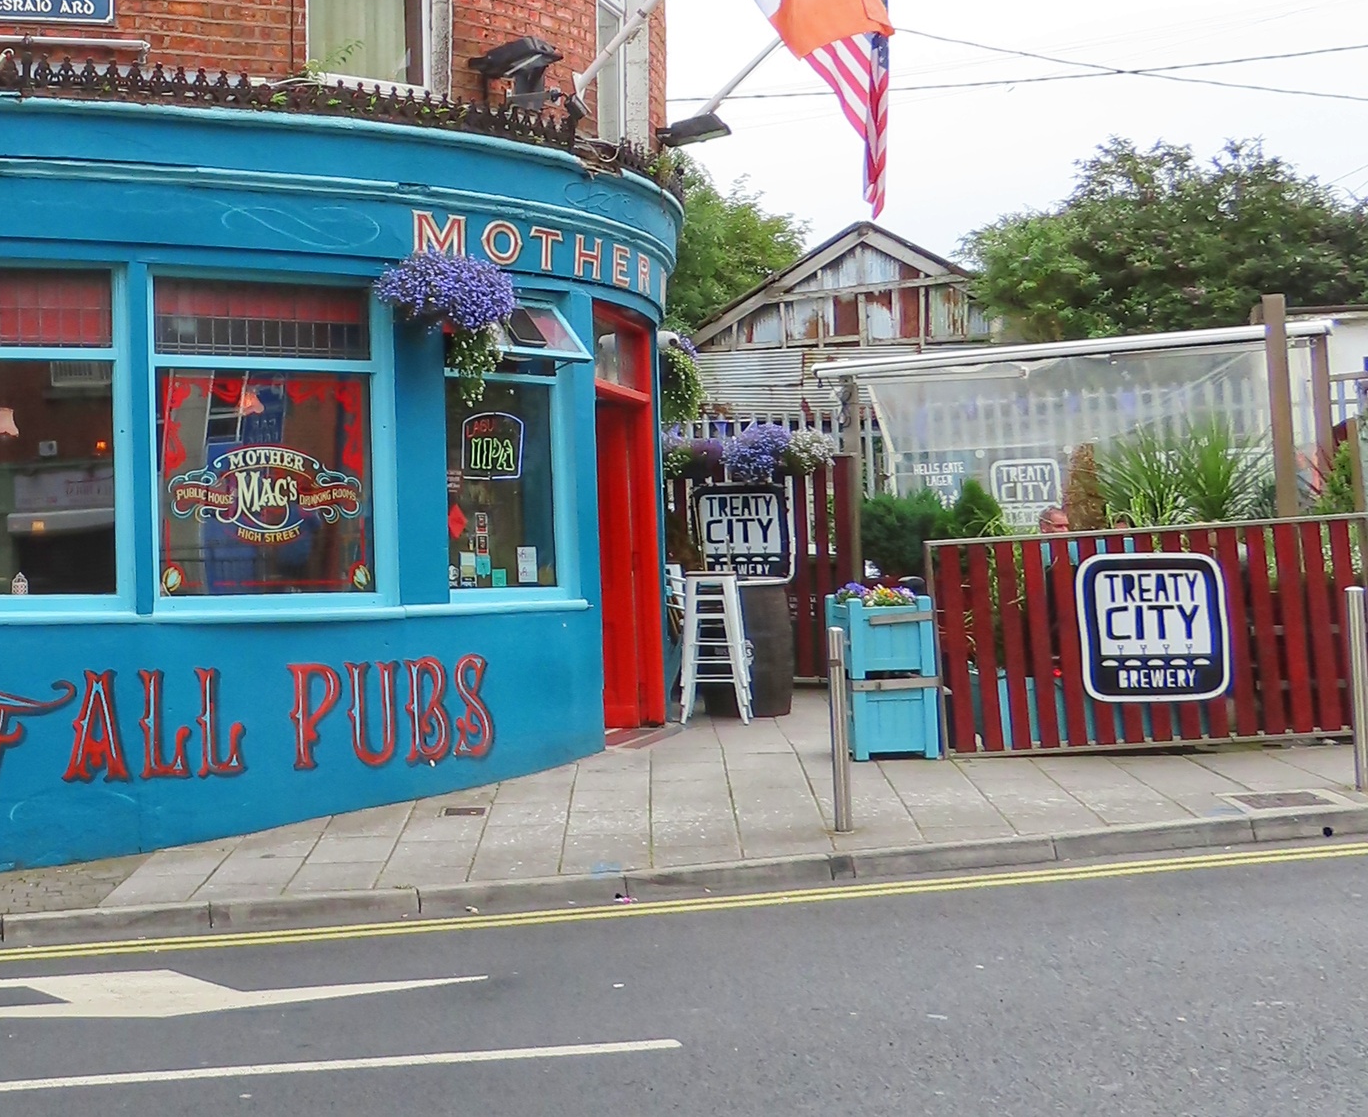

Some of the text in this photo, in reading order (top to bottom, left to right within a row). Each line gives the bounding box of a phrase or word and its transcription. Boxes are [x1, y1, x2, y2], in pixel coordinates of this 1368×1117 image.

[412, 209, 651, 295] MOTHER
[228, 450, 306, 471] MOTHER
[470, 437, 515, 471] IPA
[913, 462, 965, 475] HELLS GATE
[1001, 465, 1052, 482] TREATY
[926, 475, 953, 487] LAGER
[176, 487, 235, 505] PUBLIC HOUSE
[299, 488, 357, 506] DRINKING ROOMS
[1001, 482, 1052, 501] CITY
[705, 496, 773, 517] TREATY
[1004, 510, 1039, 526] BREWE
[238, 527, 301, 543] HIGH STREET
[706, 518, 774, 544] CITY
[1104, 573, 1198, 602] TREATY
[1106, 604, 1200, 640] CITY
[1118, 668, 1196, 688] BREWERY
[61, 667, 247, 783] ALL
[286, 652, 494, 771] PUBS
